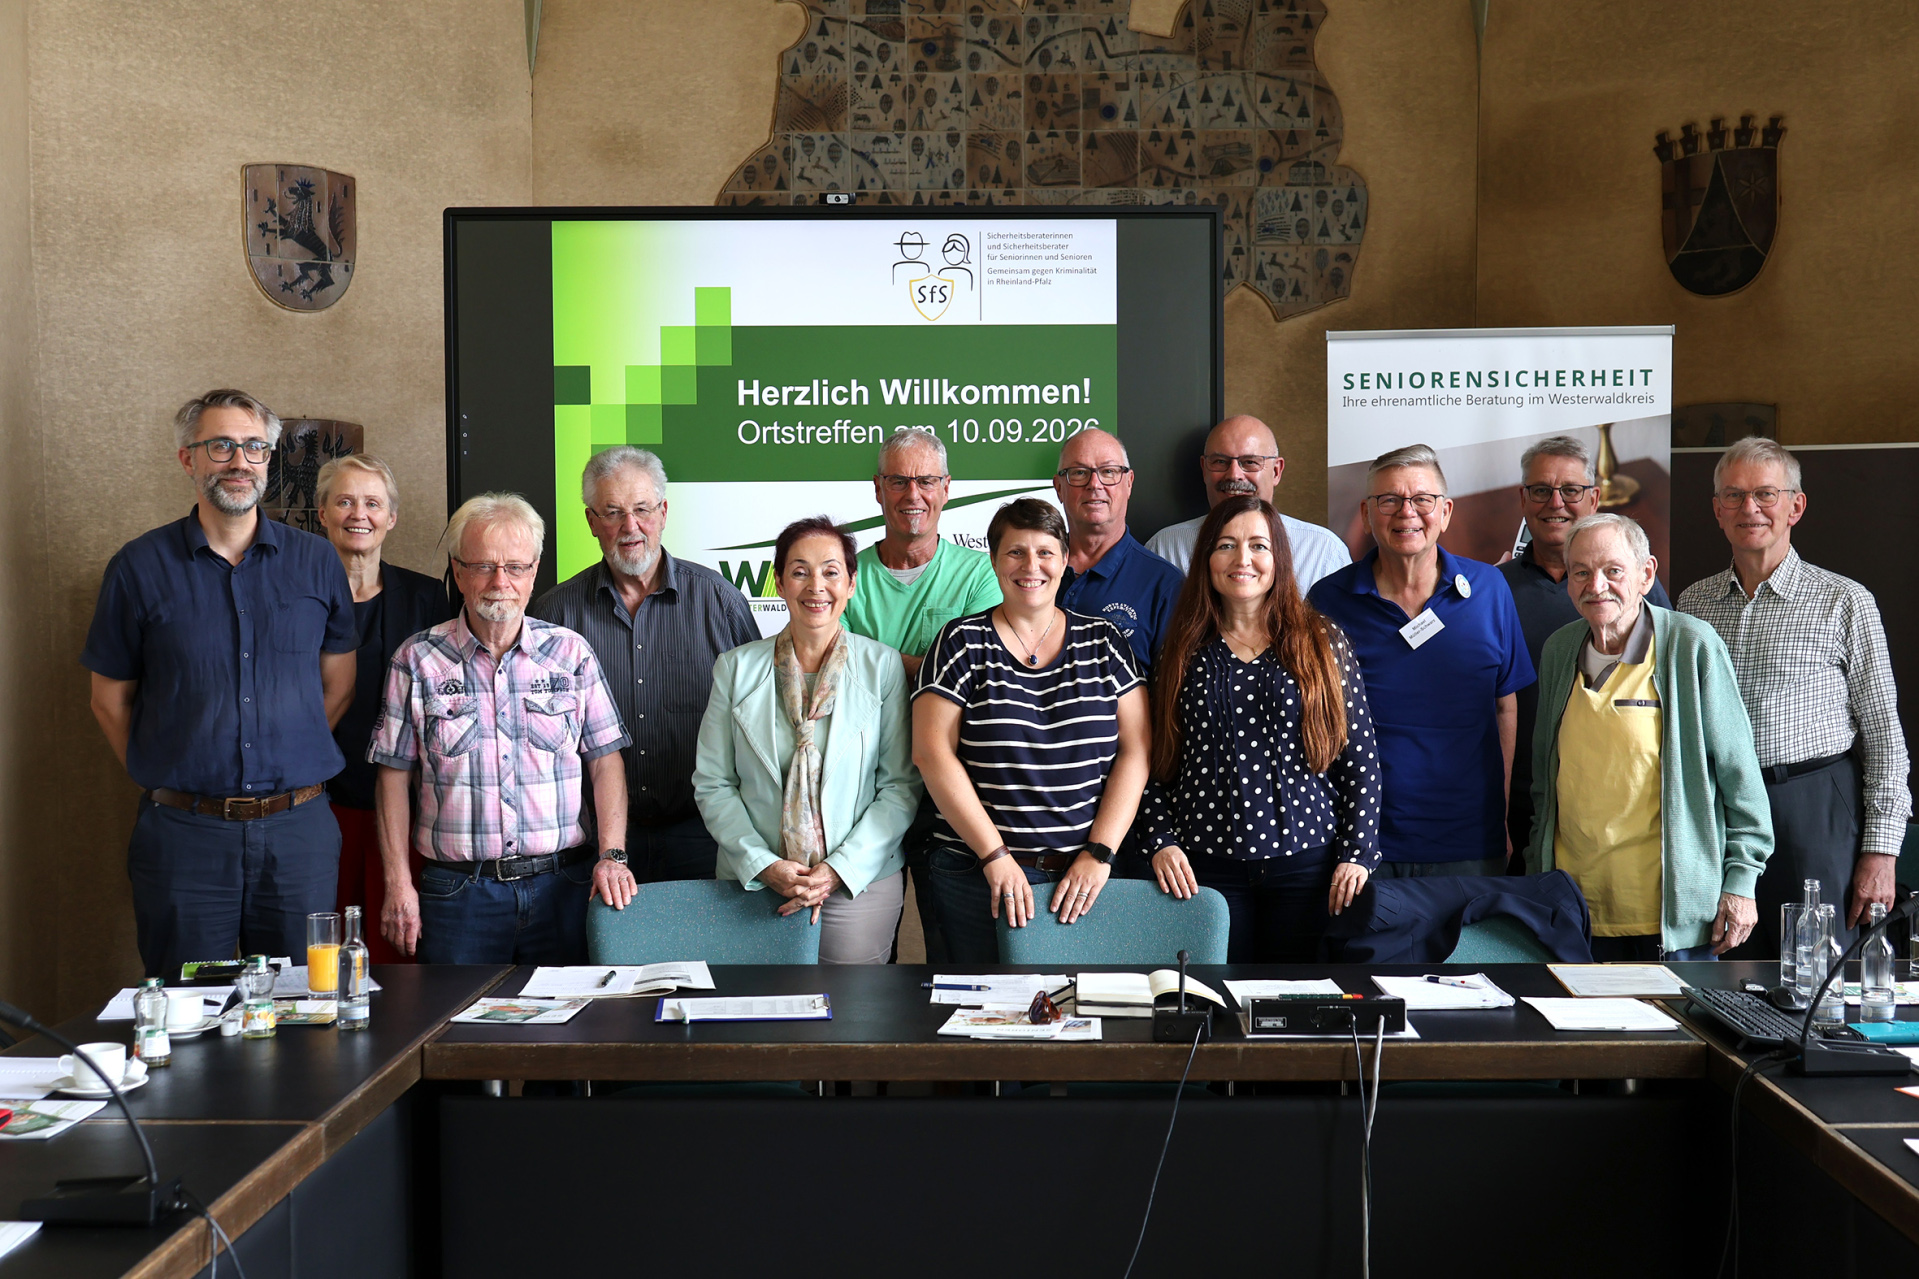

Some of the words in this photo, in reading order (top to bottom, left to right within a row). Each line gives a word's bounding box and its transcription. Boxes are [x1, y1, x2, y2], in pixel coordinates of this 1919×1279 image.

[987, 232, 1074, 240] Sicherheitsberaterinnen
[987, 242, 1001, 250] und
[1003, 242, 1069, 250] Sicherheitsberater
[987, 253, 998, 261] für
[999, 253, 1043, 261] Seniorinnen
[1045, 253, 1059, 261] und
[1060, 253, 1093, 261] Senioren
[987, 267, 1030, 275] Gemeinsam
[1055, 267, 1097, 275] Kriminalität
[996, 278, 1052, 286] Rheinland-Pfalz
[917, 285, 948, 304] SfS
[1343, 368, 1653, 391] SENIORENSICHERHEIT
[738, 379, 869, 406] Herzlich
[880, 377, 1091, 405] Willkommen!
[1342, 395, 1368, 408] Ihre
[1371, 394, 1462, 407] ehrenamtliche
[1466, 393, 1524, 409] Beratung
[1528, 393, 1544, 405] im
[1548, 391, 1655, 405] Westerwaldkreis
[737, 419, 884, 445] Ortstreffen
[953, 533, 988, 549] West
